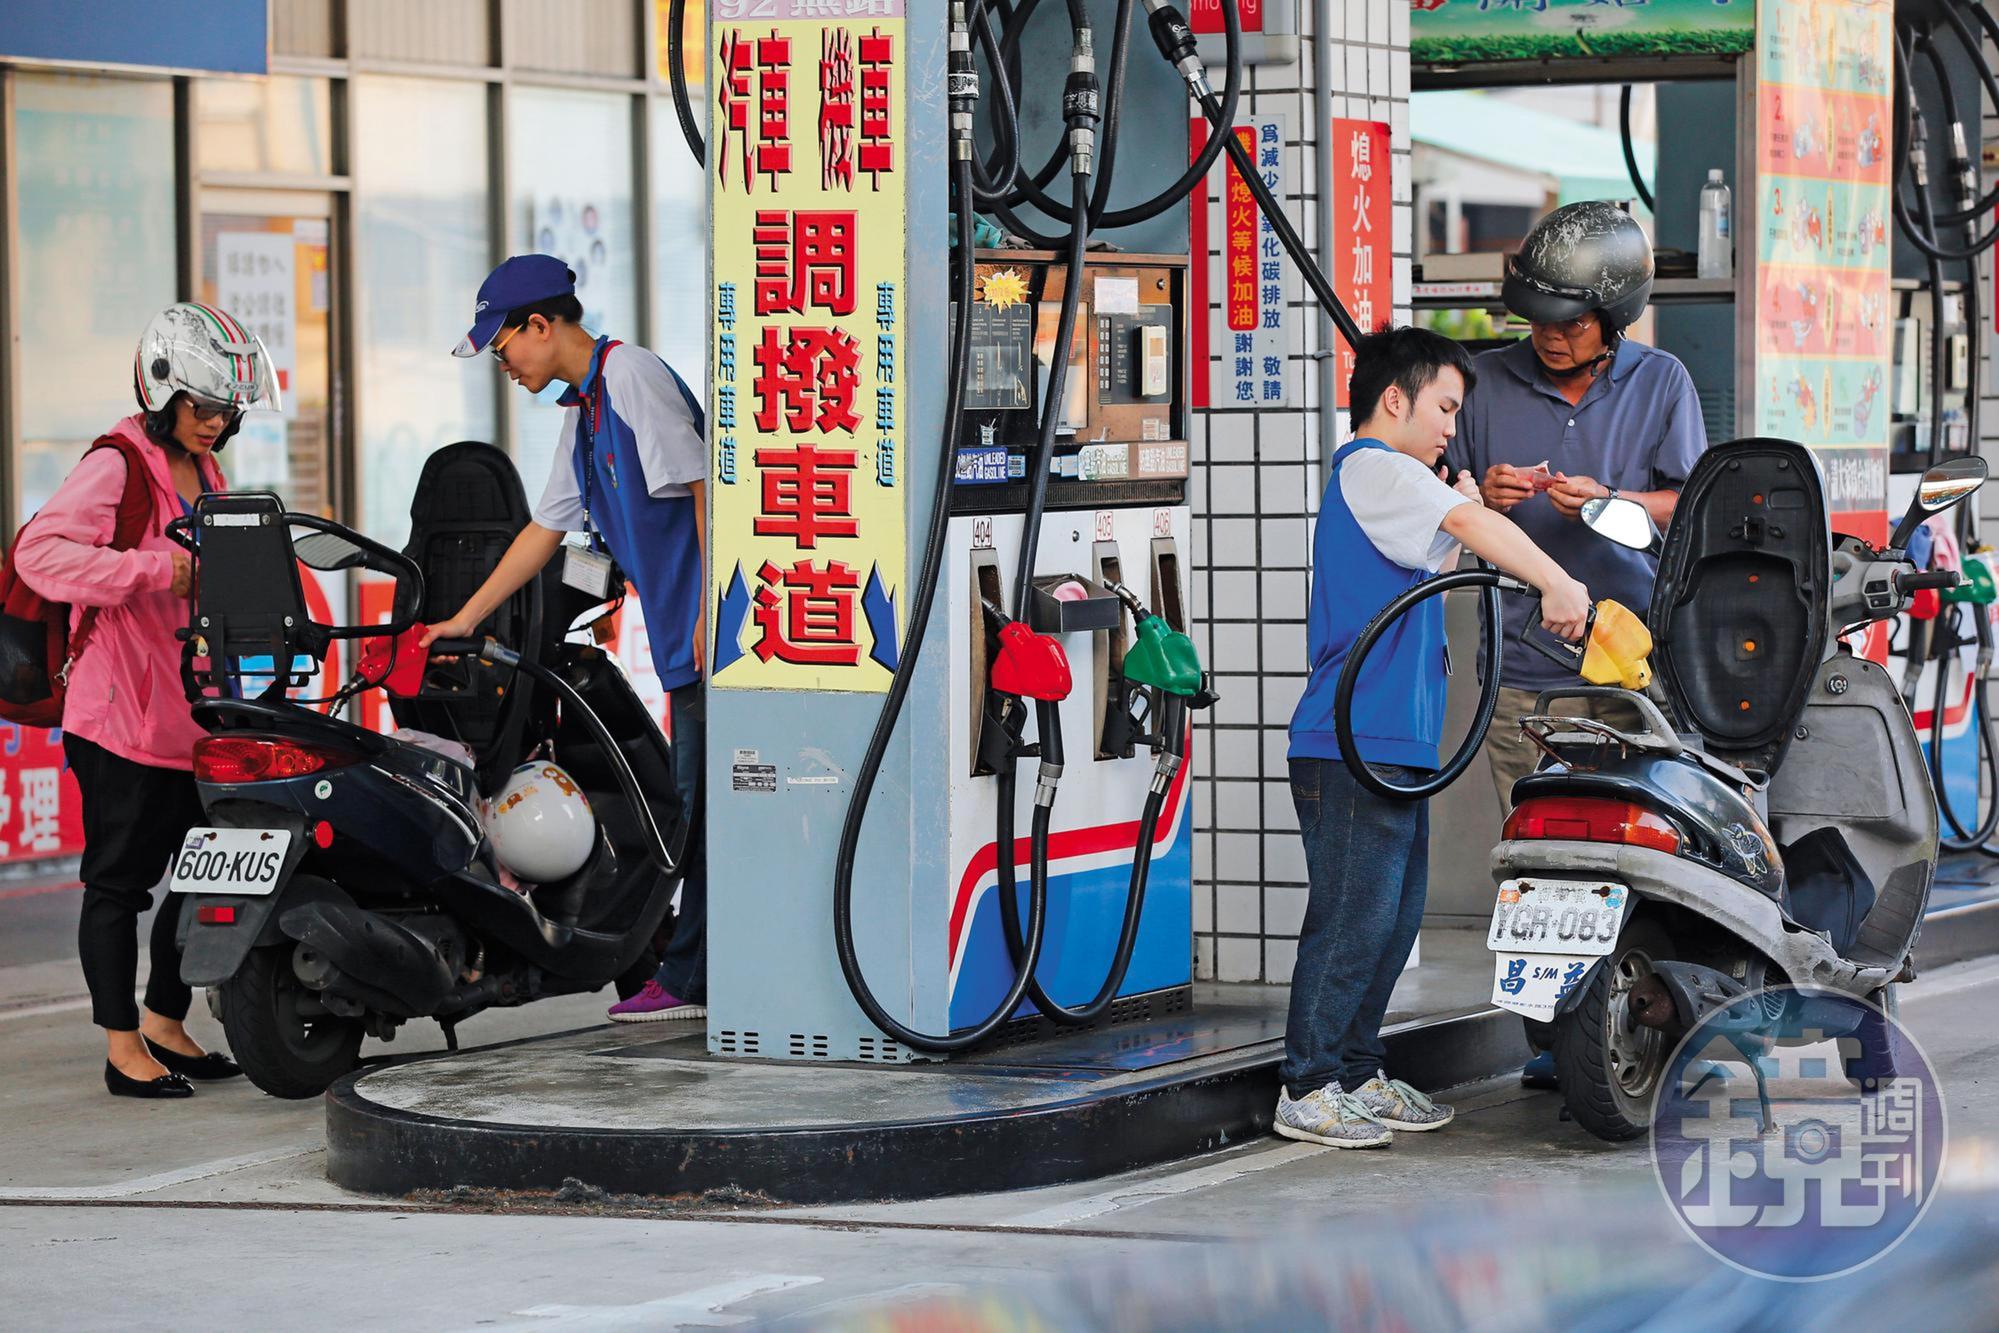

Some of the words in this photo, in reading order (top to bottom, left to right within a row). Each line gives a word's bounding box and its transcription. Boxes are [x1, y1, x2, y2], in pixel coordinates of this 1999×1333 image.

[1351, 130, 1373, 334] 熄火加油
[752, 209, 864, 667] 調撥車道
[984, 451, 1006, 465] UNLEADED
[984, 465, 1006, 480] GASOLINE
[974, 521, 991, 543] 404
[1097, 515, 1112, 537] 405
[1153, 512, 1169, 534] 406
